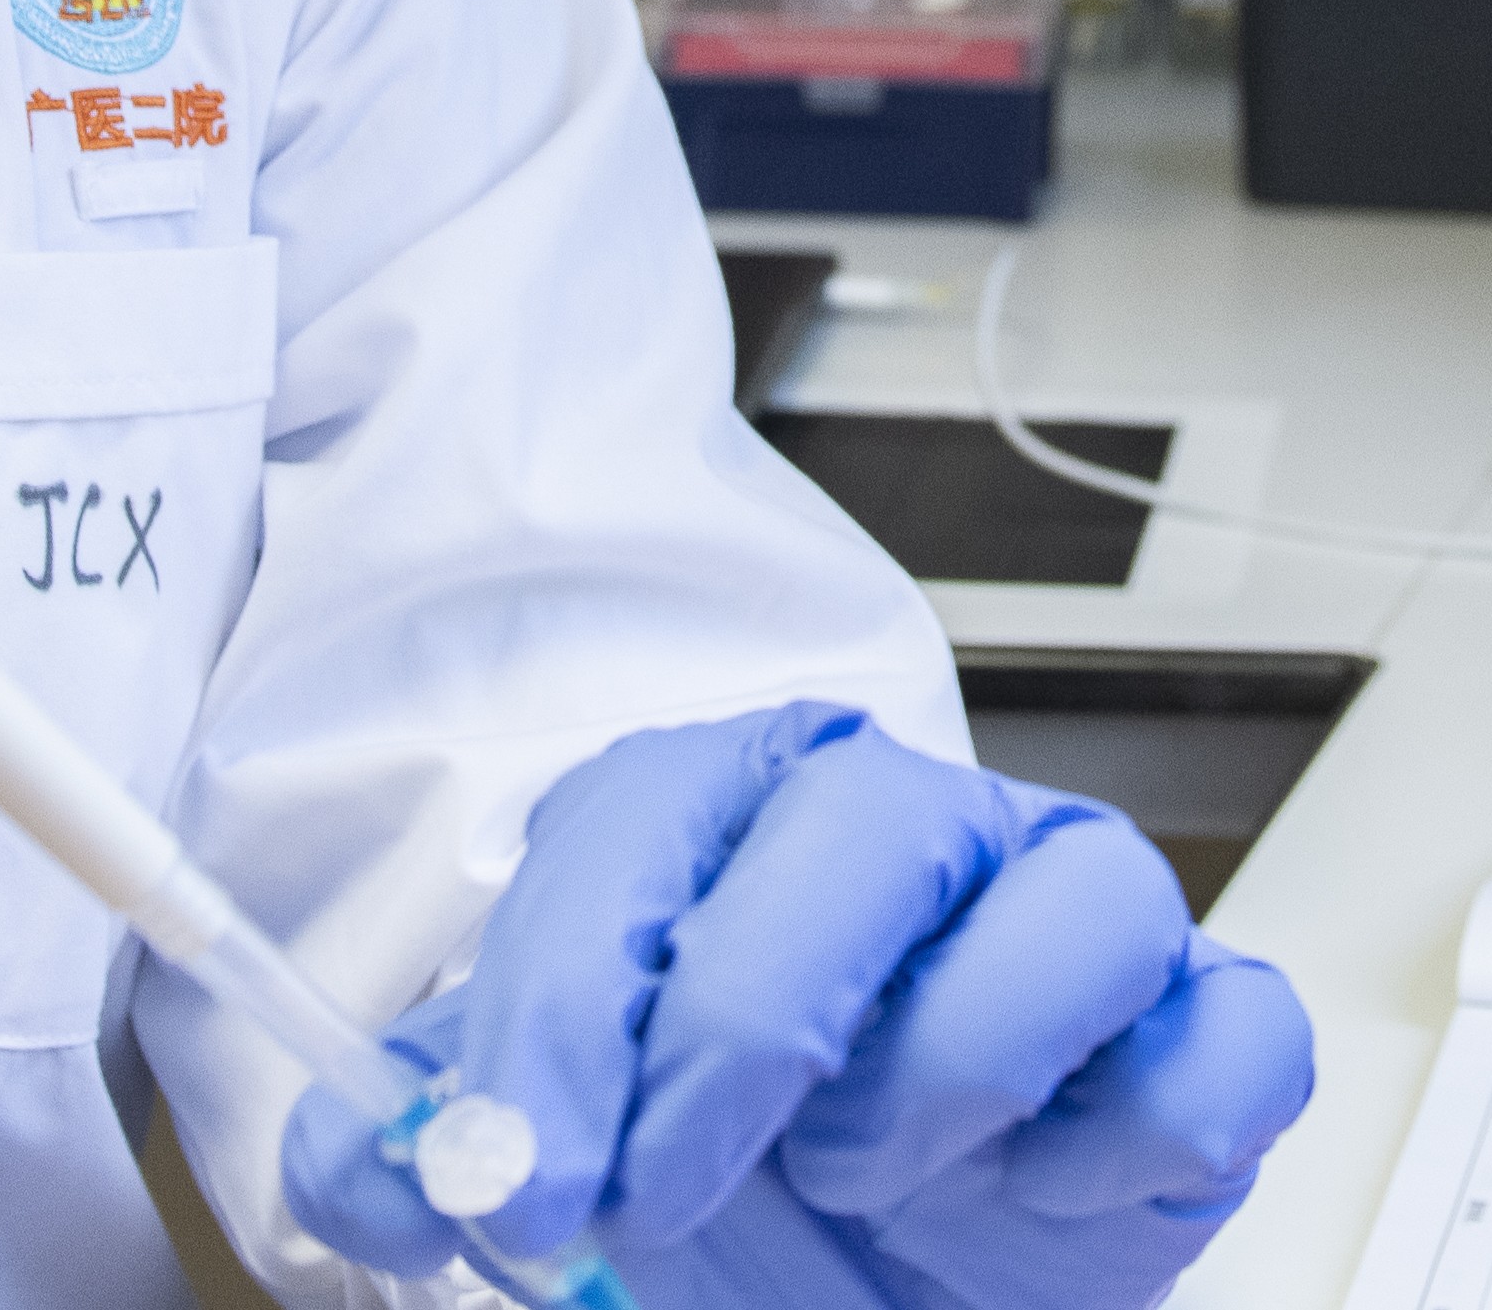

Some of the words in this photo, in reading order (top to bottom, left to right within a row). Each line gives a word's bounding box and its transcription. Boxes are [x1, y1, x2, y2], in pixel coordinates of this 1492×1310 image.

[25, 81, 228, 152] 广医二院
[17, 481, 163, 592] JCX
